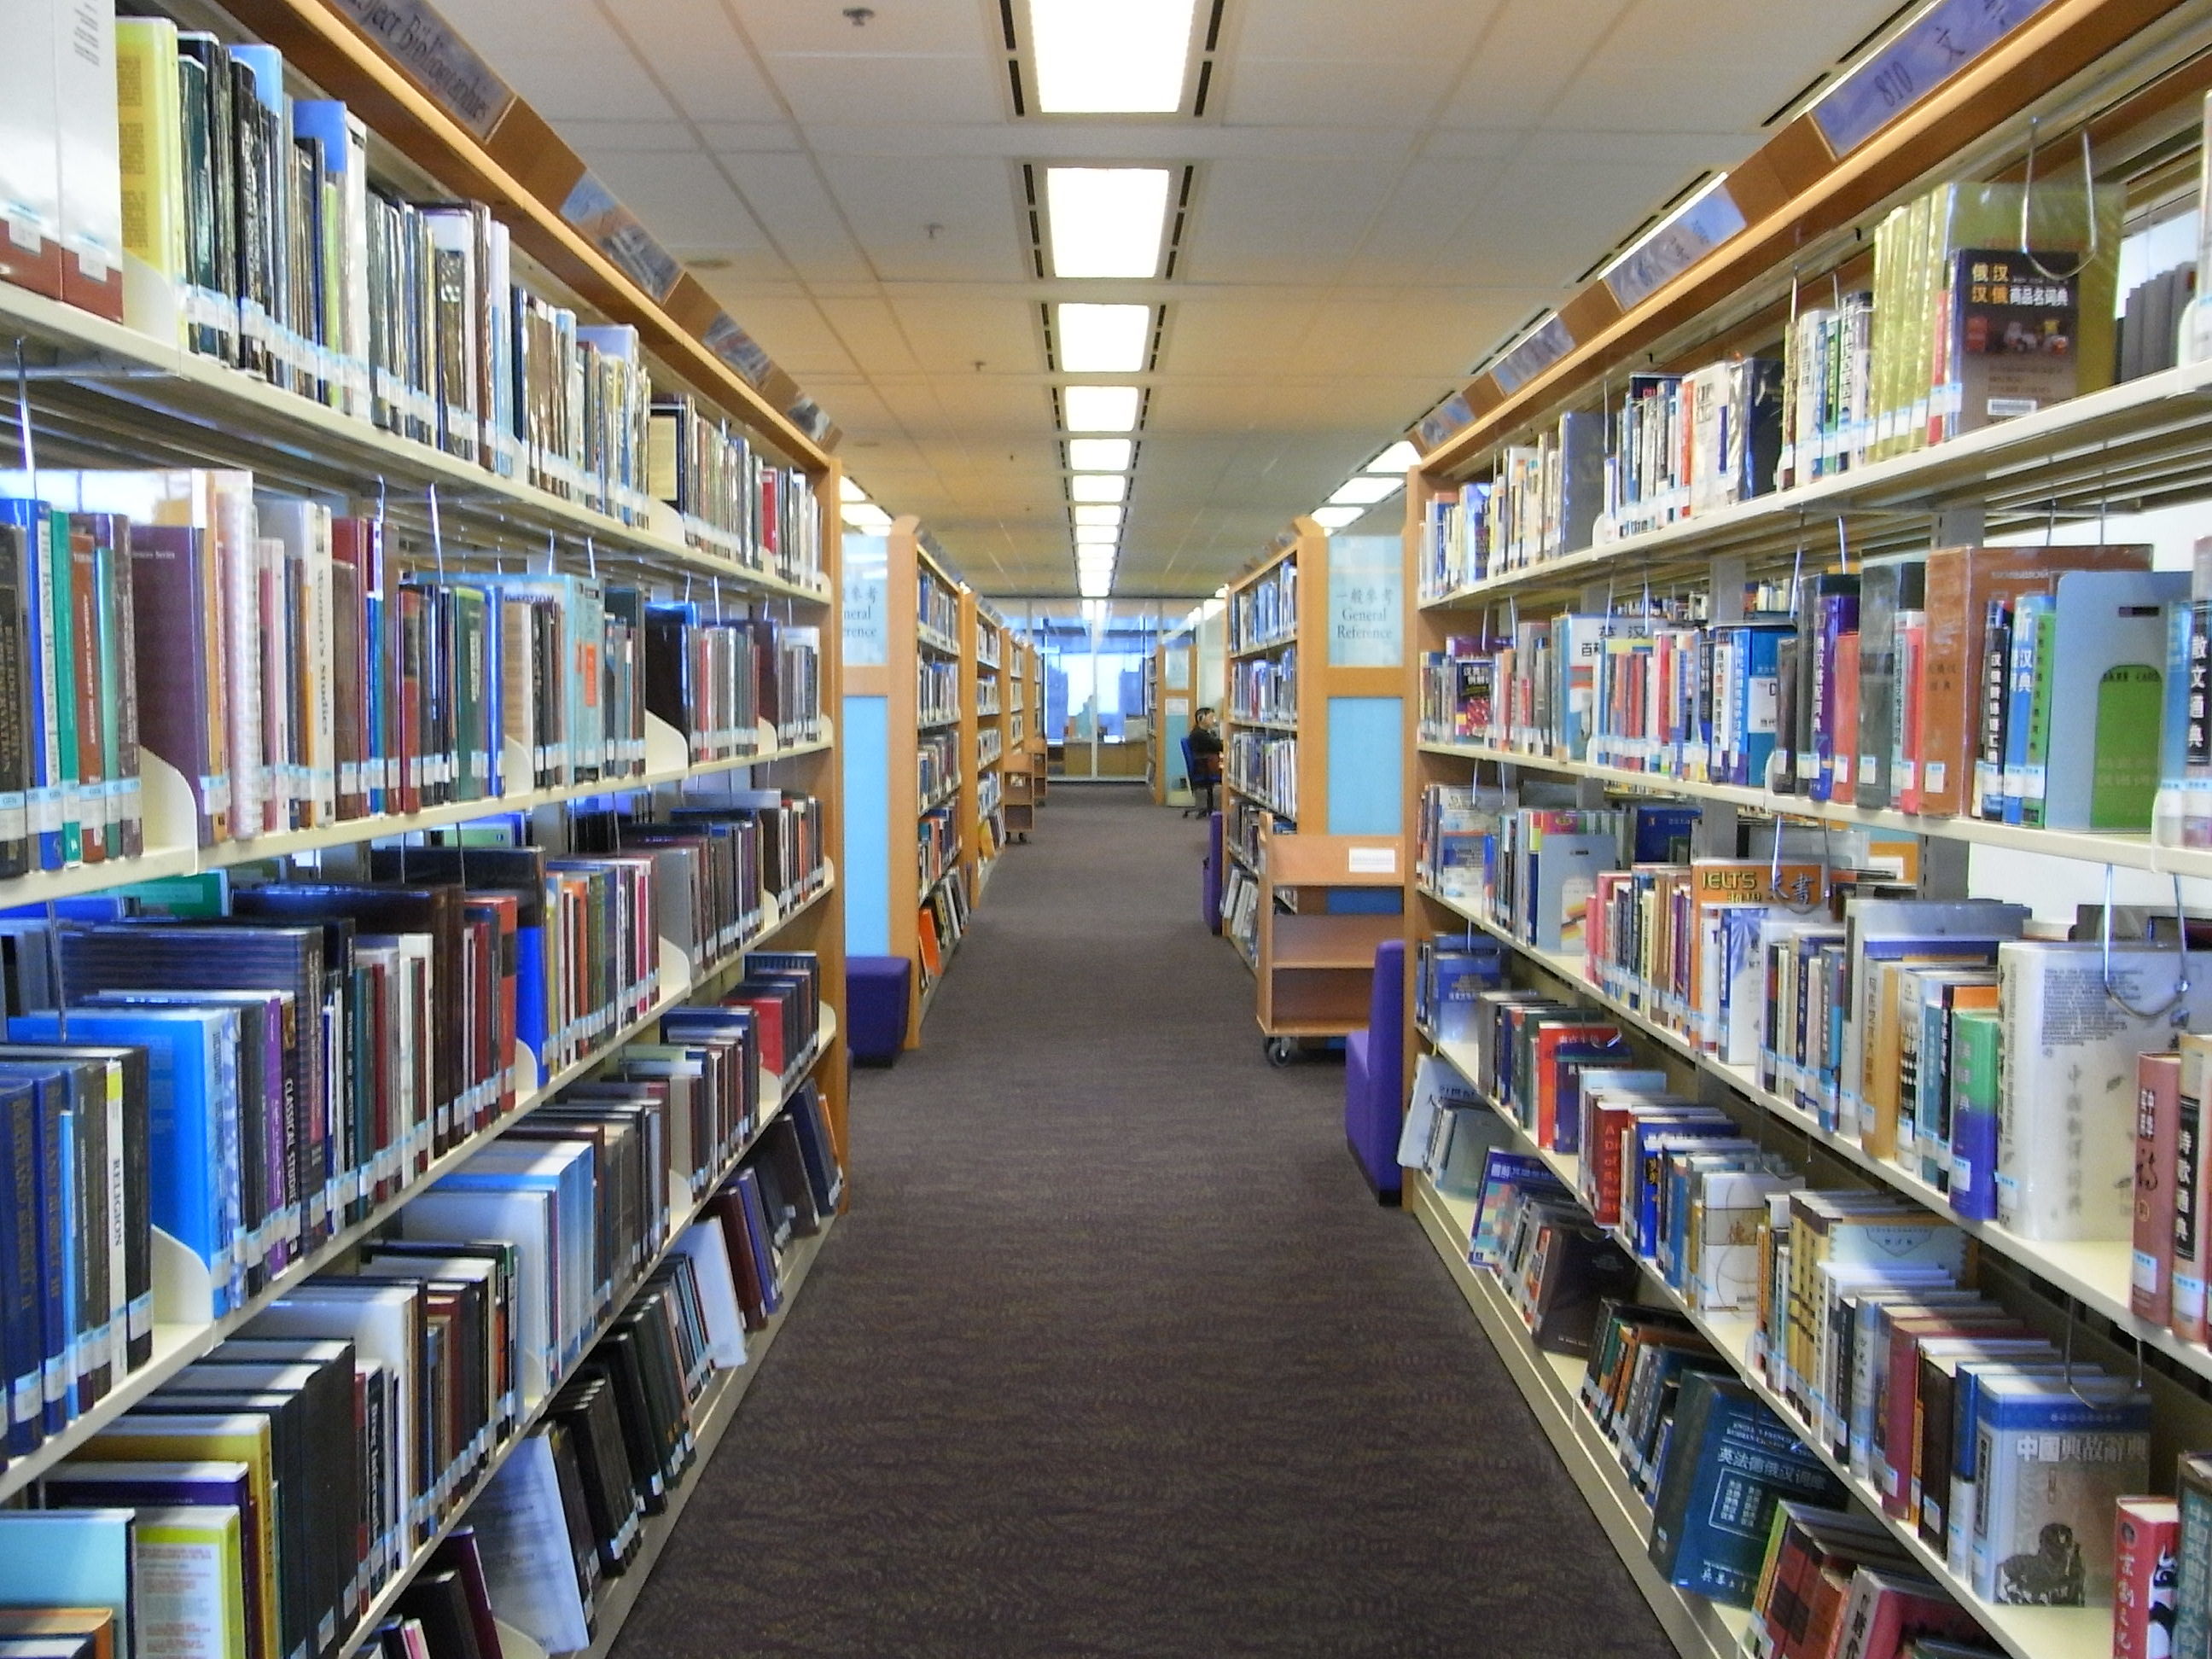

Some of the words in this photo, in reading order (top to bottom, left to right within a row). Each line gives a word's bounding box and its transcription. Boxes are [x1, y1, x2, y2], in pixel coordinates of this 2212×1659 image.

[844, 605, 871, 620] neral
[1342, 607, 1386, 622] General
[1336, 624, 1393, 639] Reference
[1702, 870, 1757, 890] IELTS
[285, 1078, 295, 1150] CLASSICAL
[287, 1150, 297, 1207] STUDIE
[113, 1157, 122, 1247] RELIGION
